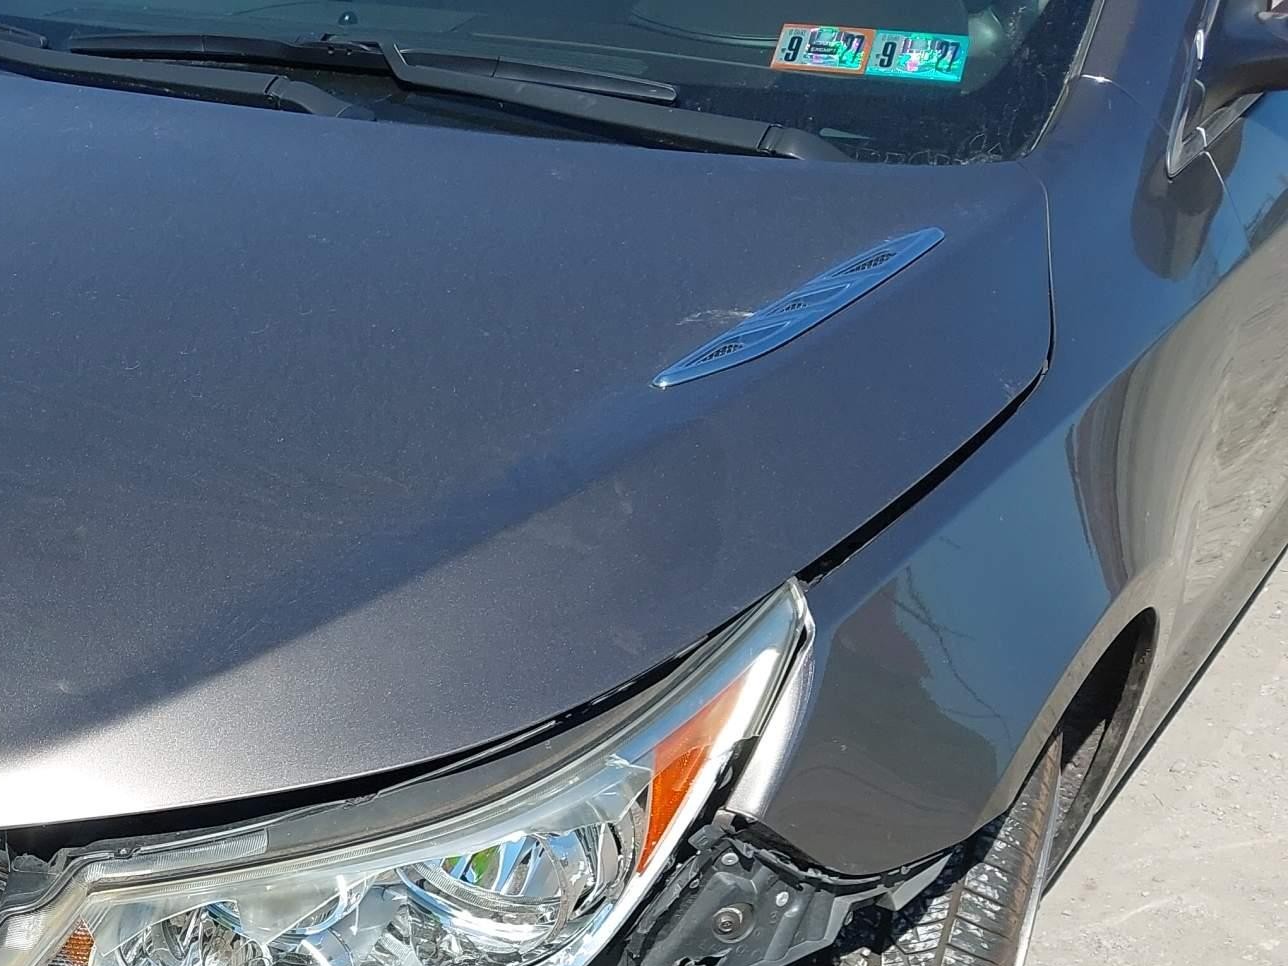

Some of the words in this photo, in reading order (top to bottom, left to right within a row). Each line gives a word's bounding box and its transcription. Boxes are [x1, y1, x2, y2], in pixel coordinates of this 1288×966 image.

[784, 36, 803, 61] 9
[839, 33, 864, 64] 27
[879, 42, 897, 67] 9
[935, 40, 960, 72] 27
